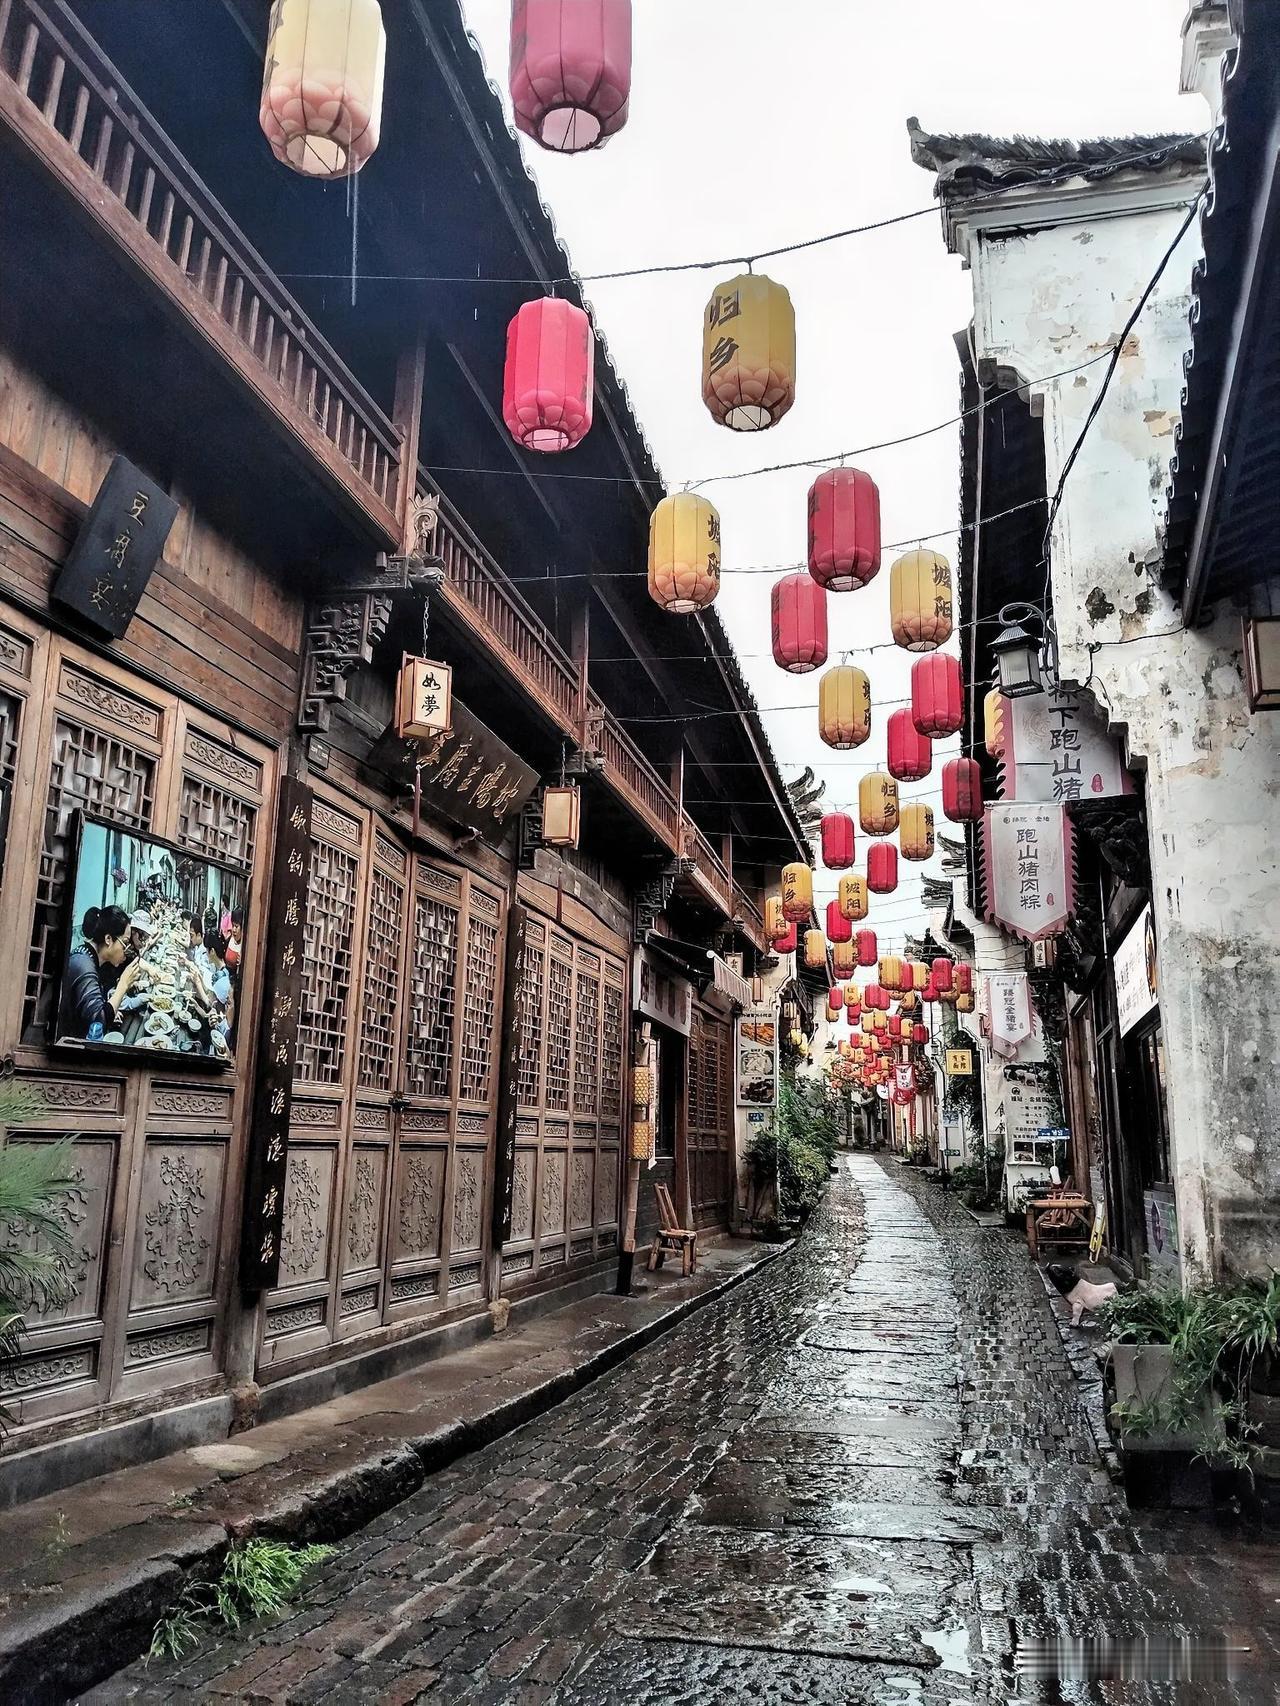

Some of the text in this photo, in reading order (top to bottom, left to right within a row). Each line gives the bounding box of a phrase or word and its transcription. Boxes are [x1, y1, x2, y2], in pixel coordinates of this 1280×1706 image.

[709, 287, 740, 377] 归乡
[1016, 828, 1041, 911] 跑山猪肉粽
